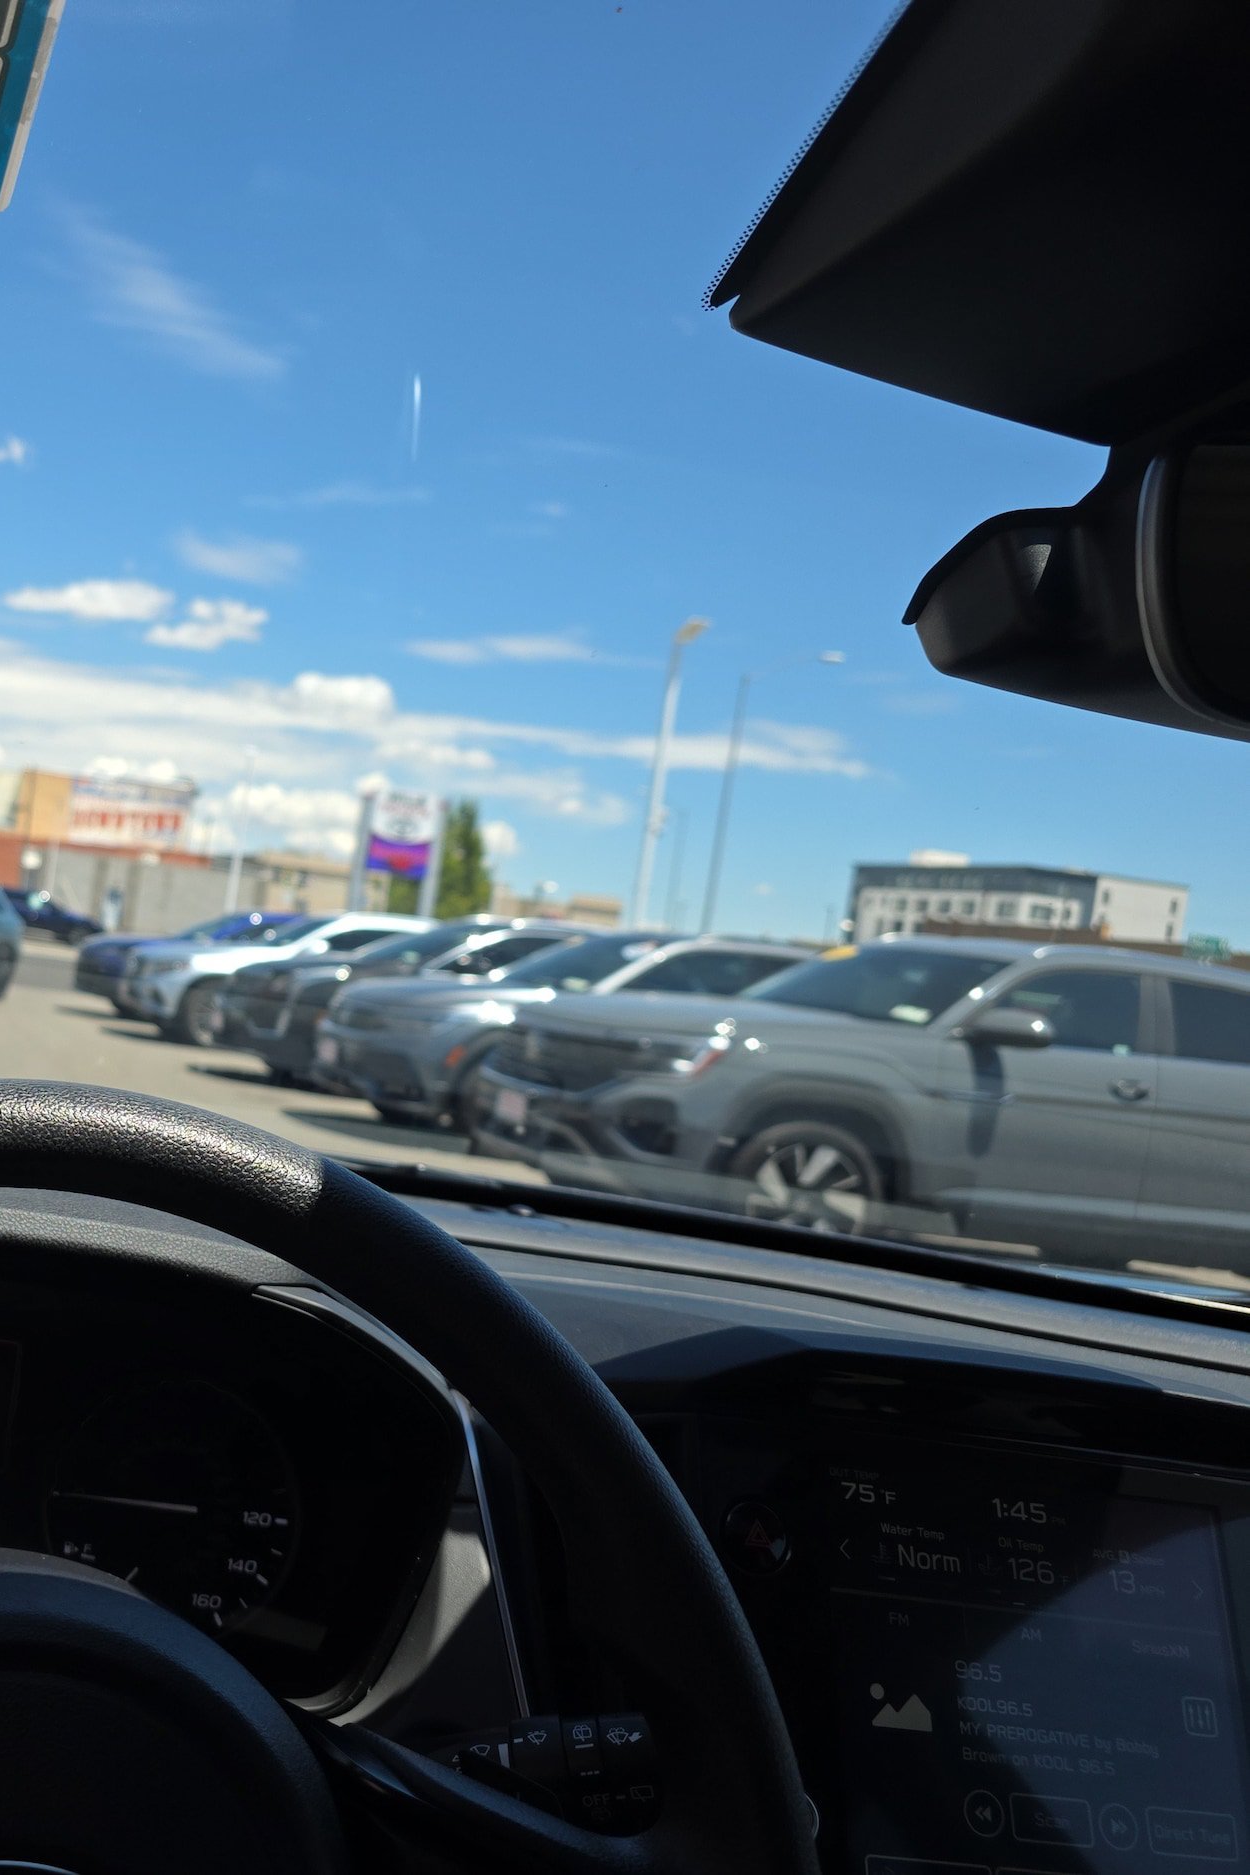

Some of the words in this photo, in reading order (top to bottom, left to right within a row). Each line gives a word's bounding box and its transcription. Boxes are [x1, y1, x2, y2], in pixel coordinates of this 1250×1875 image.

[841, 1481, 876, 1503] 75
[243, 1510, 272, 1528] 120
[992, 1497, 1047, 1524] 1:45
[880, 1521, 912, 1536] Water
[916, 1526, 945, 1542] Temp
[1016, 1538, 1045, 1554] Temp
[227, 1557, 258, 1574] 140
[897, 1543, 962, 1573] Norm
[1007, 1557, 1055, 1585] 126
[1109, 1569, 1136, 1594] 13
[191, 1592, 223, 1609] 160
[888, 1611, 911, 1627] FM
[1020, 1627, 1043, 1643] AM
[954, 1659, 1002, 1684] 96.5
[957, 1695, 1034, 1718] KOOL96.5
[959, 1720, 982, 1737] MY
[986, 1723, 1090, 1749] PREROGATIVE
[1094, 1737, 1113, 1754] by
[1115, 1738, 1160, 1760] Bobby
[962, 1746, 1007, 1764] Brown
[1011, 1755, 1030, 1768] on
[1033, 1752, 1075, 1773] KOOL
[1078, 1758, 1117, 1776] 96.5
[582, 1792, 610, 1807] OFF
[1153, 1824, 1194, 1842] Direct
[1199, 1827, 1232, 1846] Tune
